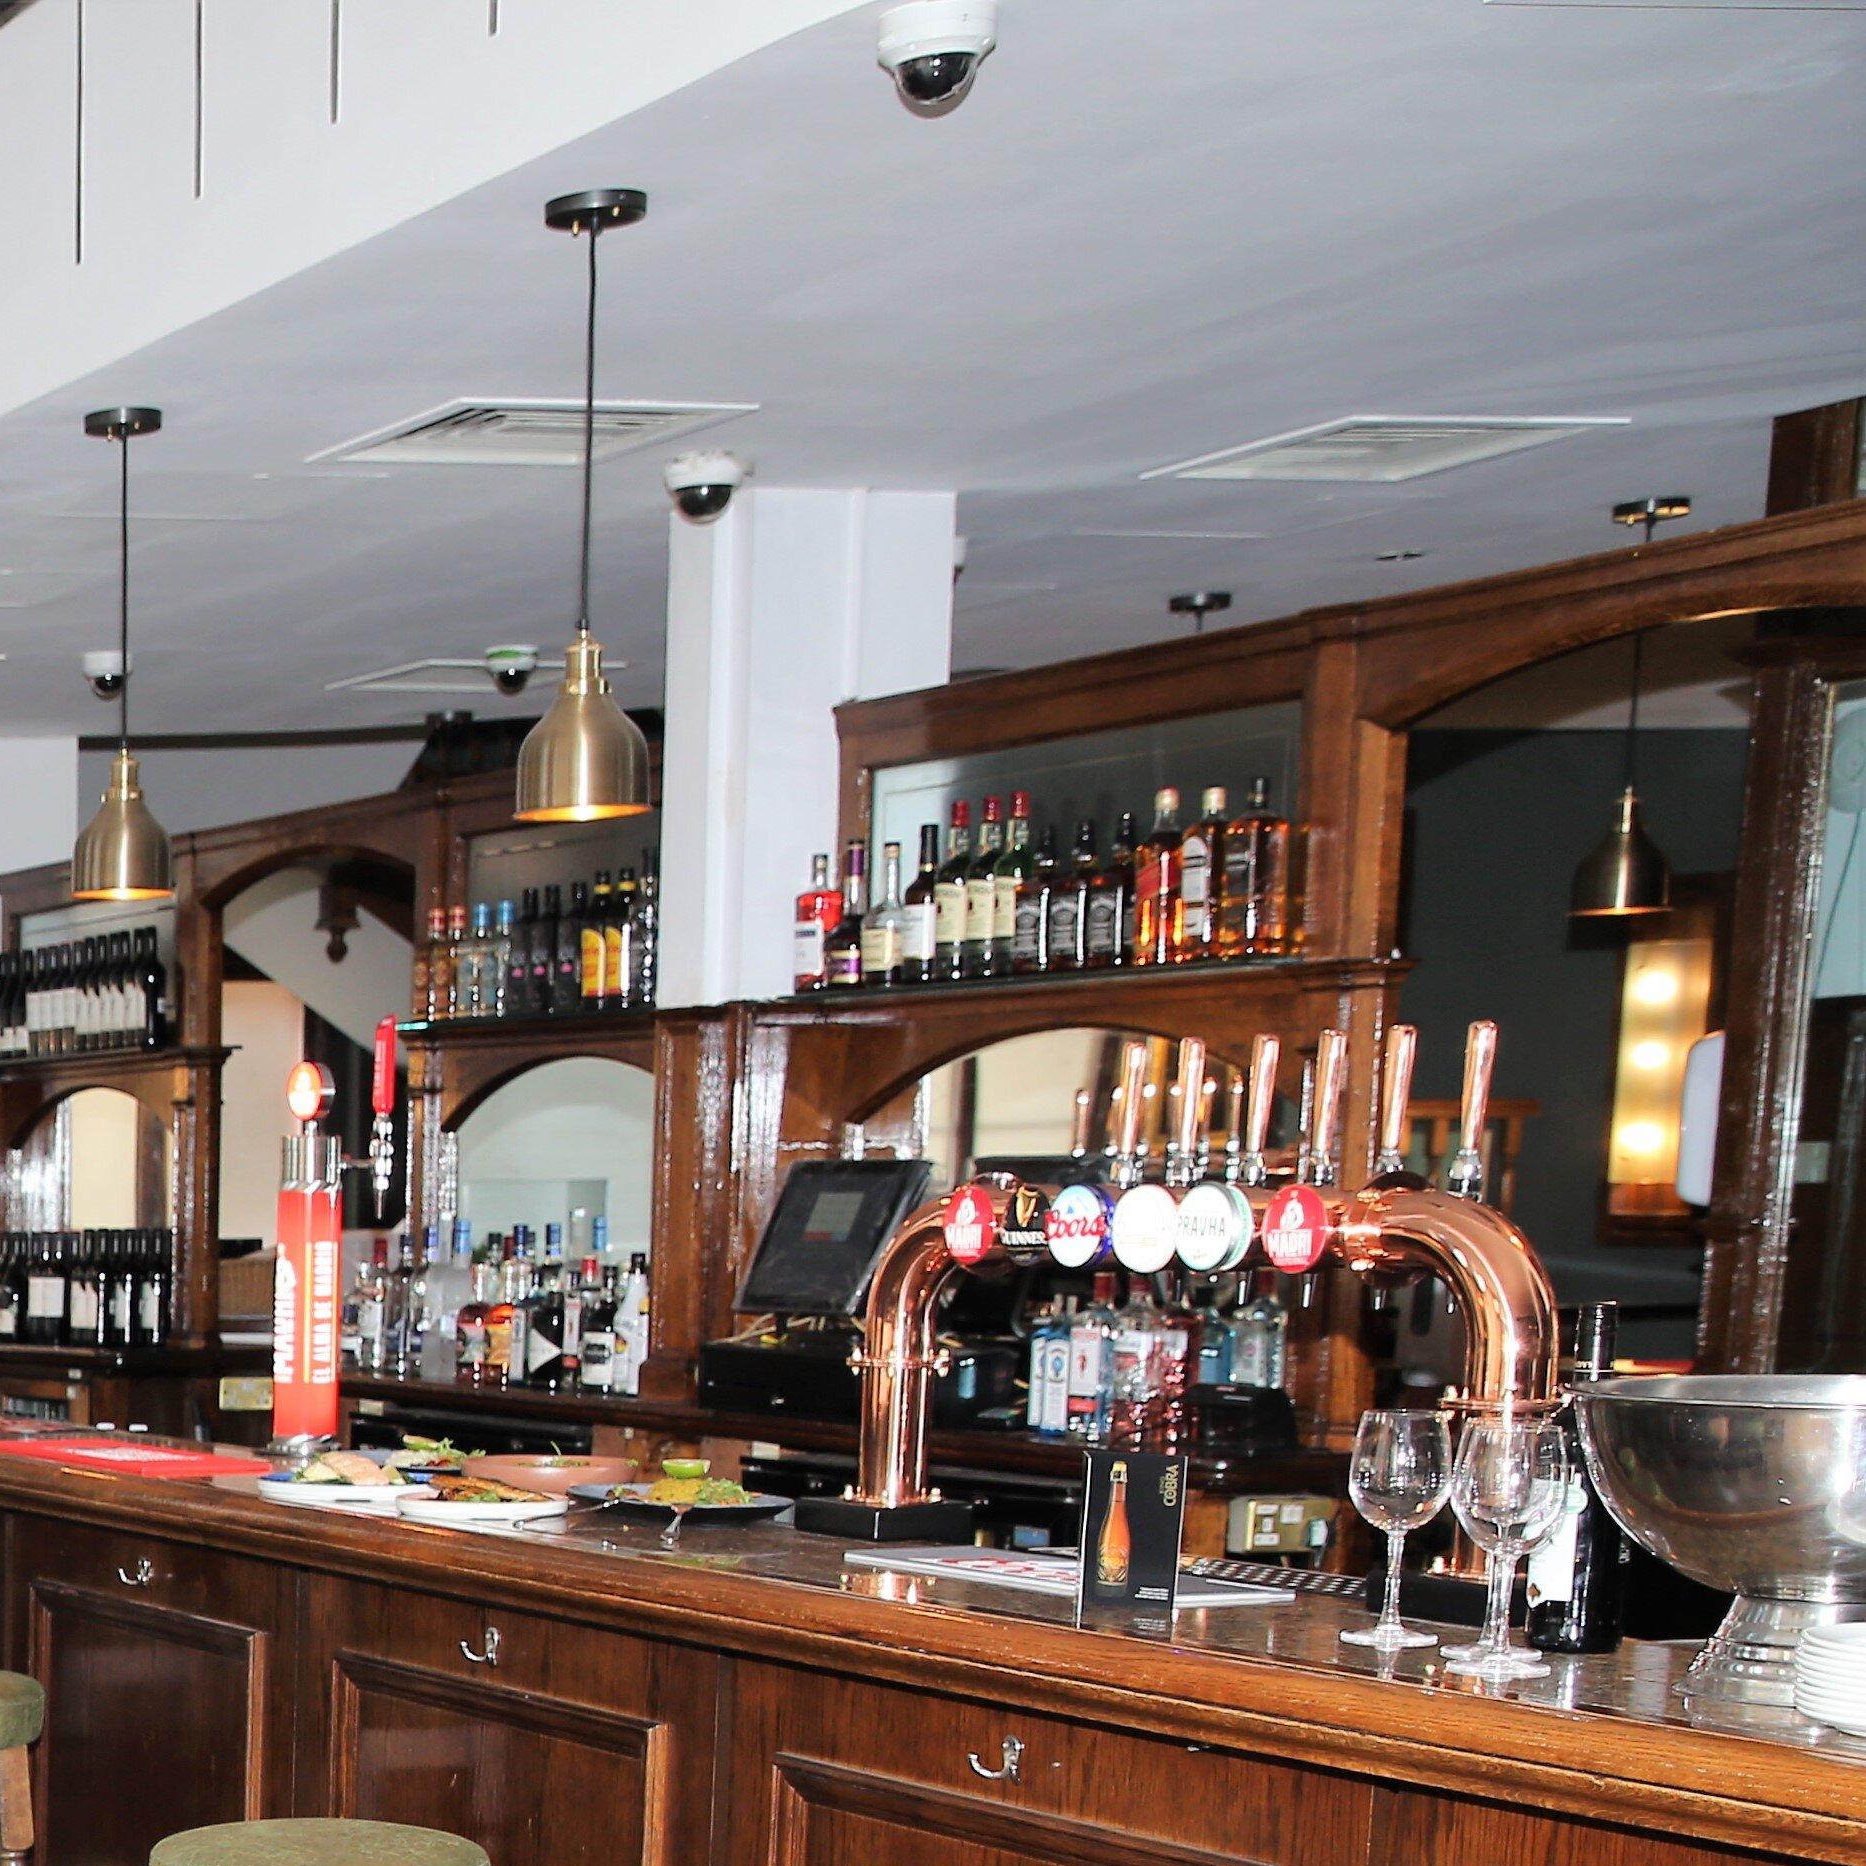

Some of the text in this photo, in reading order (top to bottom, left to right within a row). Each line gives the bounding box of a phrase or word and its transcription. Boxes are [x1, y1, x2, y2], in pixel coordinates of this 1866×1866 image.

[1000, 1230, 1048, 1245] GUINNES
[1043, 1209, 1105, 1241] Coors
[1177, 1215, 1226, 1238] PRAVHA
[1163, 1464, 1179, 1507] COBRA
